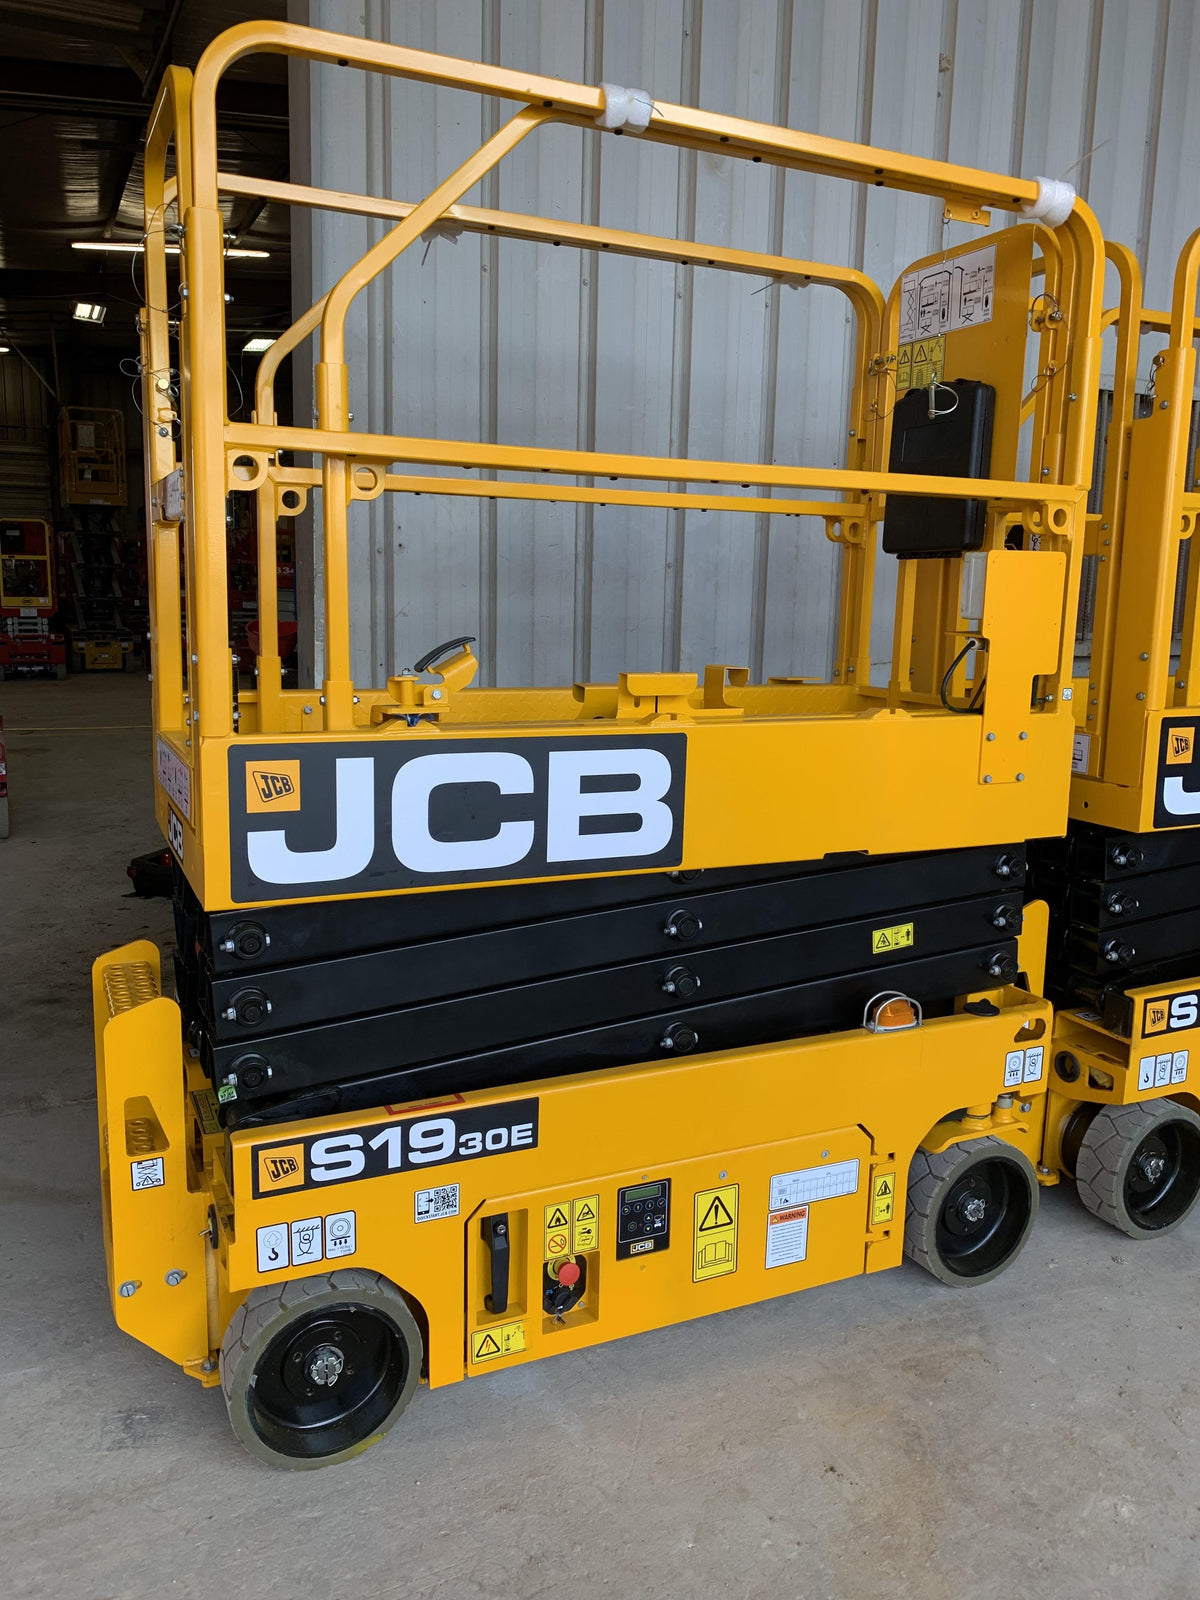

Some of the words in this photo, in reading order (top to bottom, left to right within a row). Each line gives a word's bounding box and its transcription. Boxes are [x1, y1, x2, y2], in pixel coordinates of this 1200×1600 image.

[1174, 737, 1190, 755] JCB
[260, 773, 292, 799] JCB
[247, 748, 674, 884] JCB
[168, 809, 183, 861] JCB
[1151, 1010, 1165, 1025] JCB
[270, 1156, 297, 1180] JCB
[779, 1210, 806, 1221] WARNING
[632, 1241, 652, 1252] JCB
